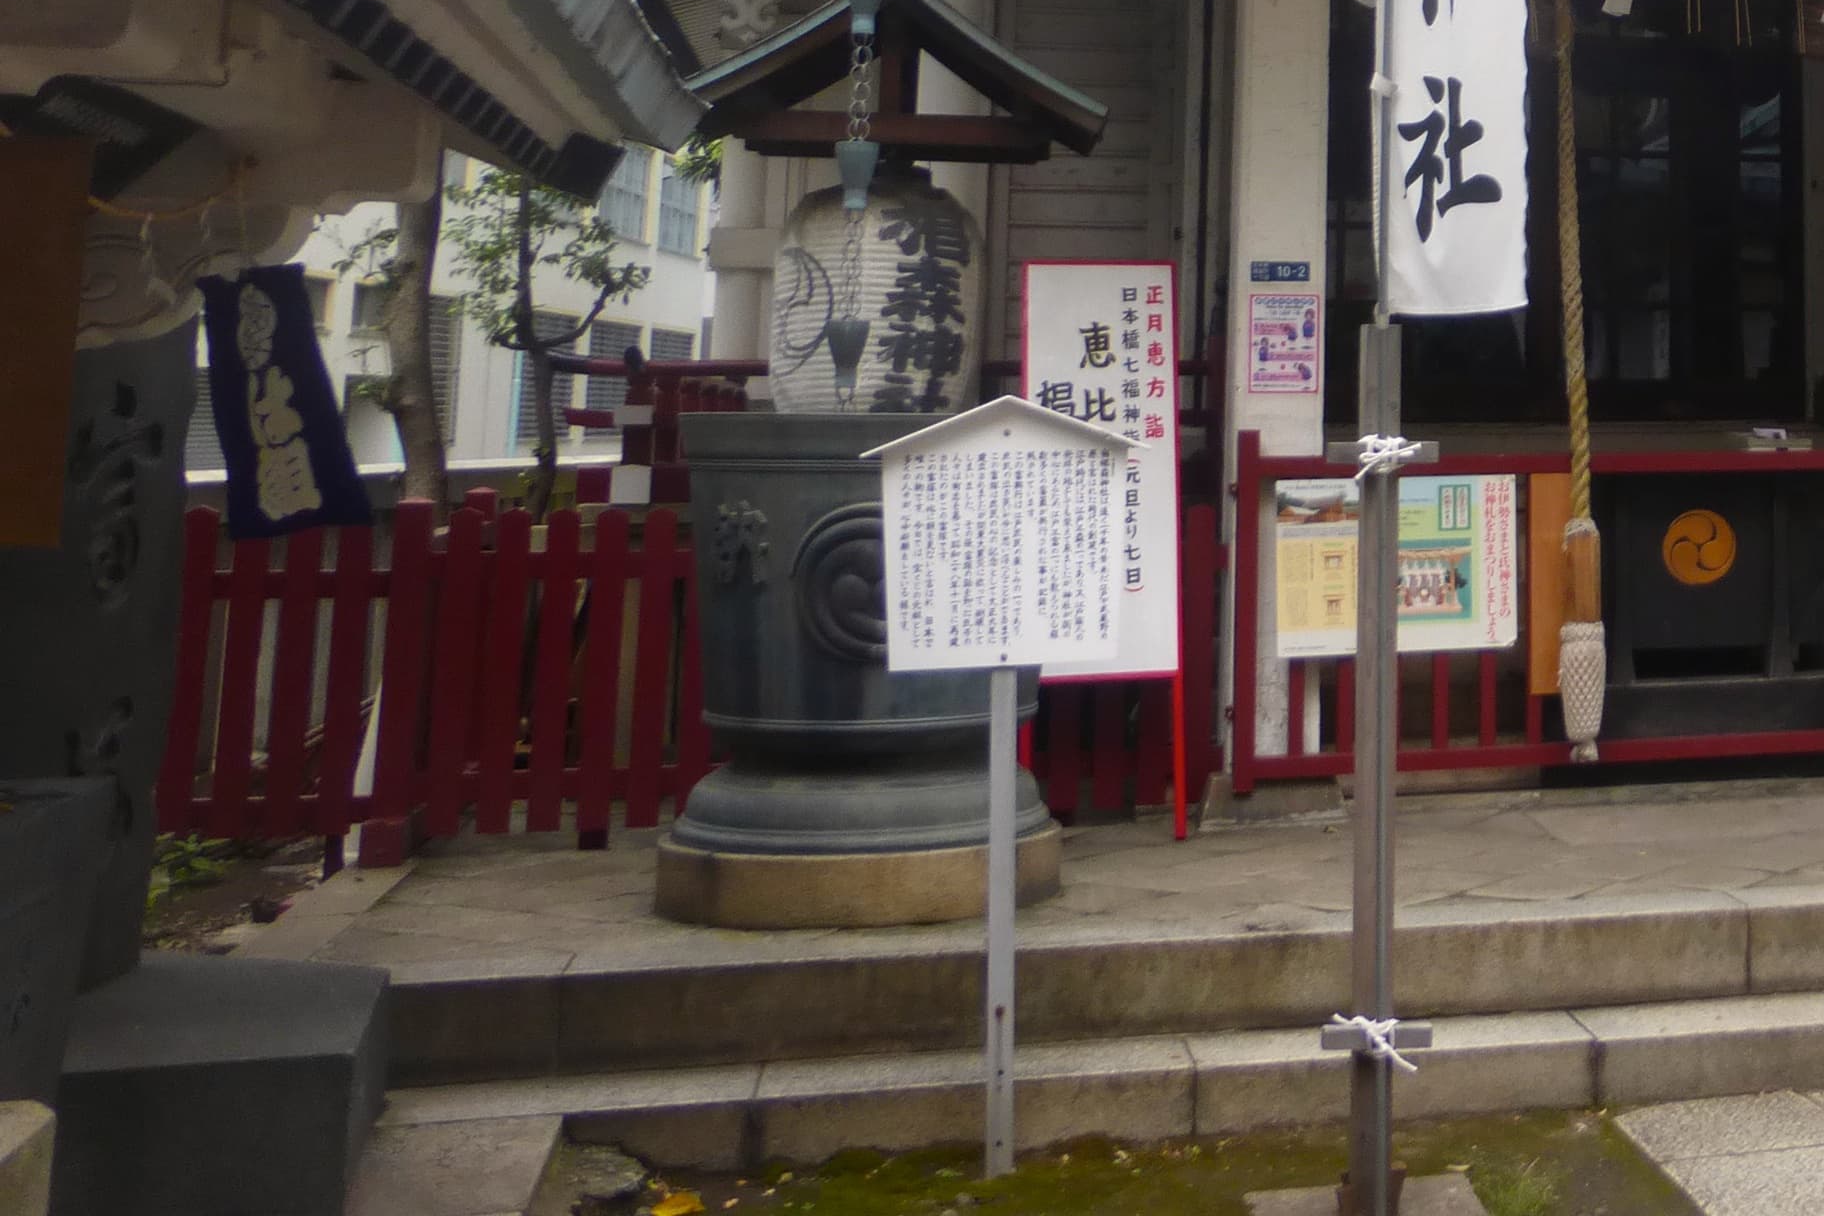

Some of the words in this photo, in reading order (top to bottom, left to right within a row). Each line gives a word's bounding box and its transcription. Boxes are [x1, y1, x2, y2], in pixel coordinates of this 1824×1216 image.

[1277, 265, 1306, 278] 10-2
[1145, 285, 1165, 439] 正月恵方詣
